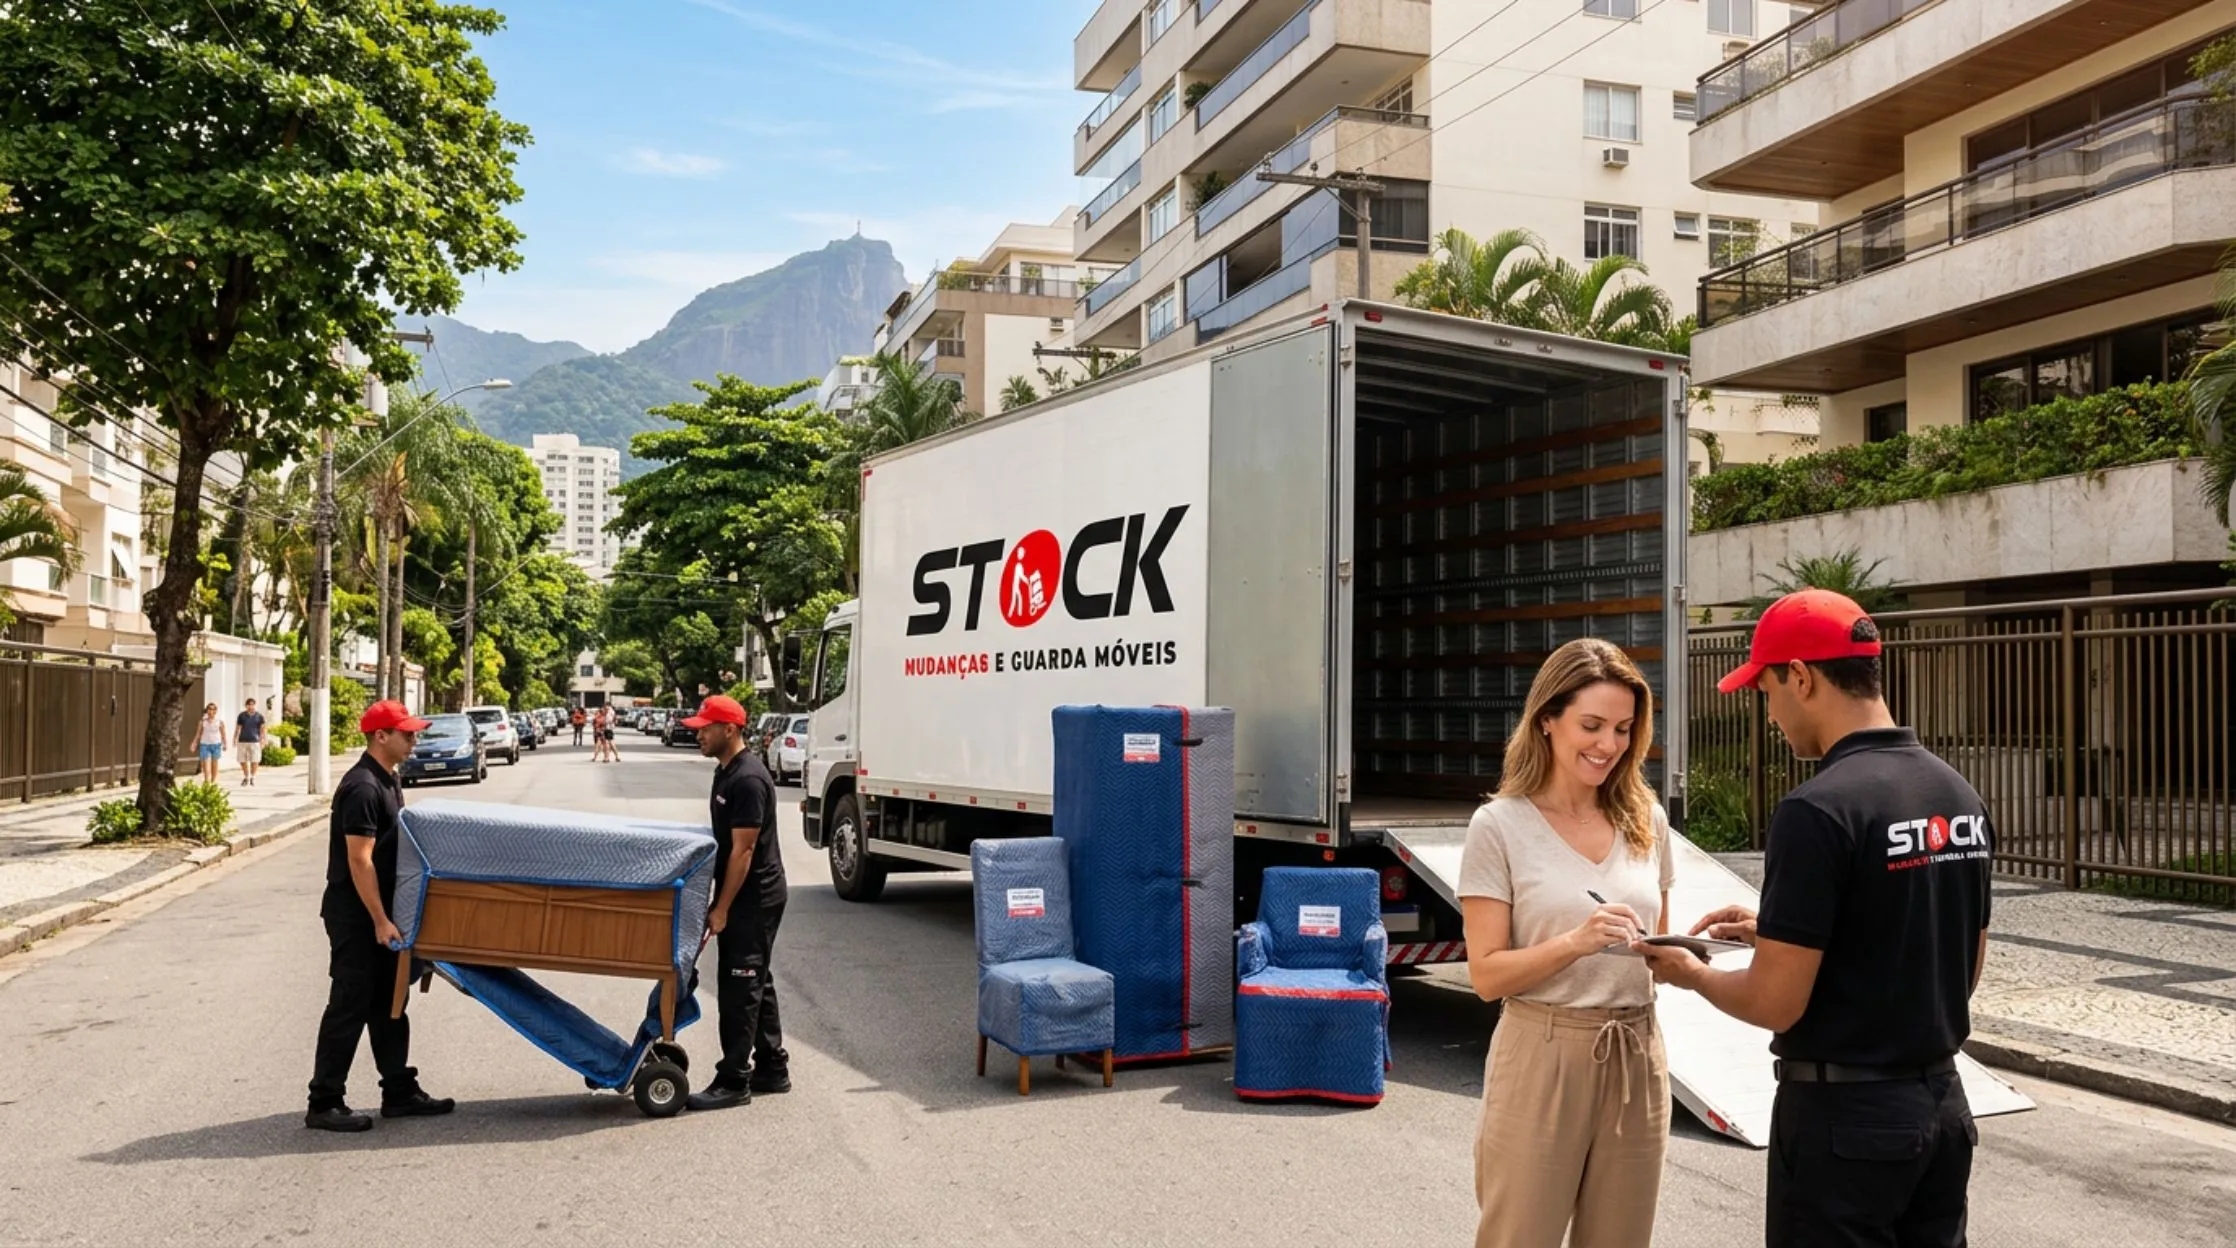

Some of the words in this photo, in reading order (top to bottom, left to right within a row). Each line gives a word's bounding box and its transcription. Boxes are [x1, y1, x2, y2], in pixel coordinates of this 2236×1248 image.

[906, 504, 1191, 636] STOCK
[905, 653, 989, 679] MUDANÇAS
[995, 652, 1004, 672] E
[1011, 647, 1087, 671] GUARDA
[1095, 638, 1177, 667] MÓVEIS
[1887, 815, 1986, 857] STOCK
